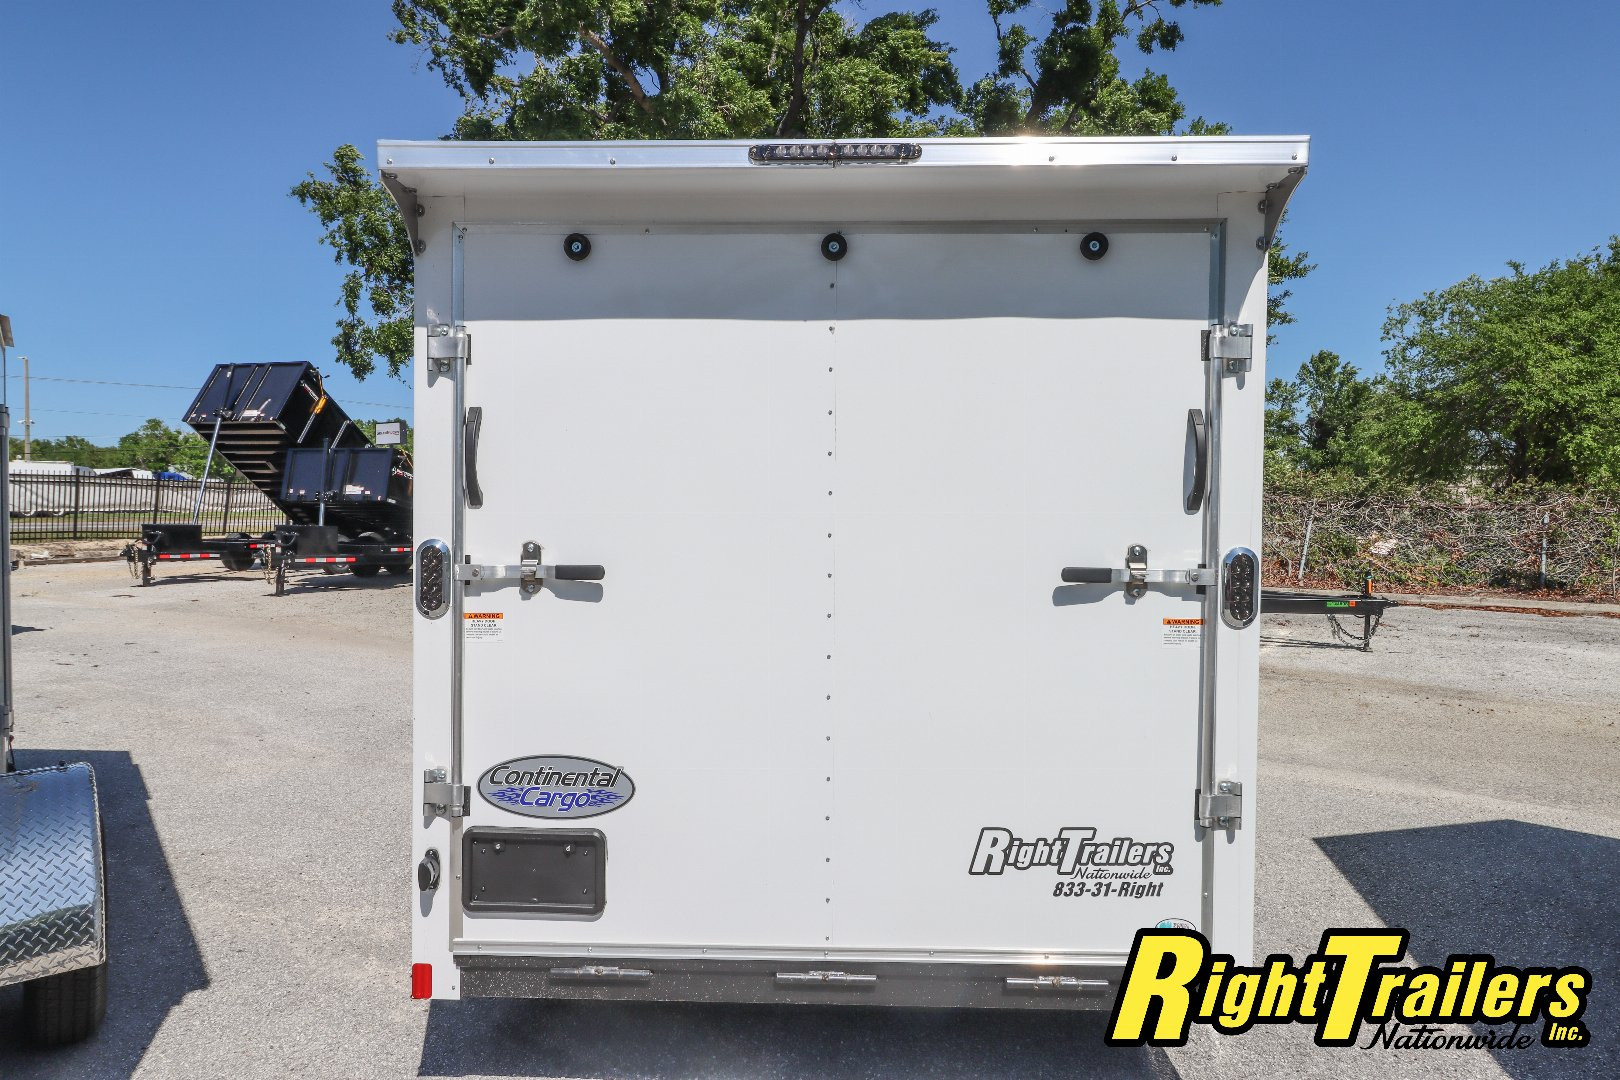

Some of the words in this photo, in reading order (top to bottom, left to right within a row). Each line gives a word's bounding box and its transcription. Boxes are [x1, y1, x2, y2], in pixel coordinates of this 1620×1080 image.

[489, 766, 623, 788] Continental
[519, 787, 591, 812] Cargo
[1070, 867, 1153, 880] Nationwide
[1053, 882, 1164, 899] 833-31-Right
